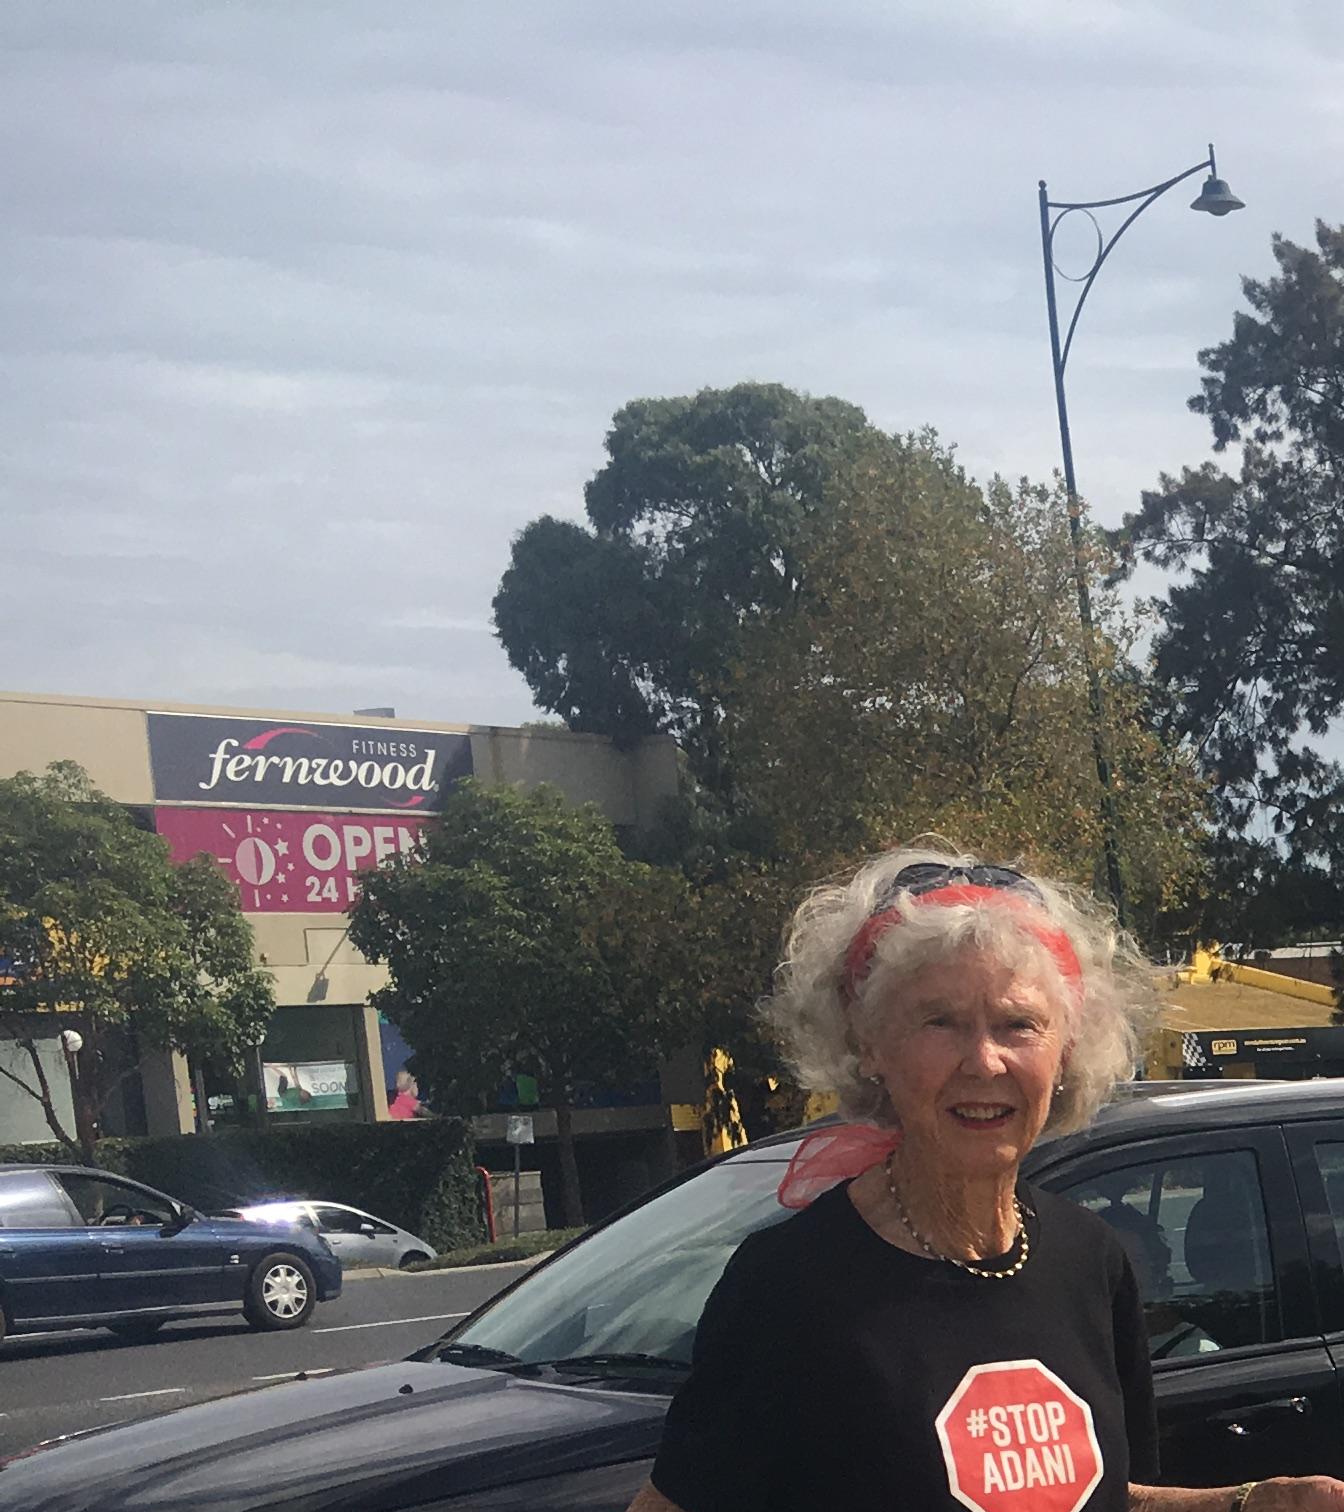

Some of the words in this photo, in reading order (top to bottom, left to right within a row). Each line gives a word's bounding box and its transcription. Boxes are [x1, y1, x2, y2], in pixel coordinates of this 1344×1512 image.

[199, 738, 437, 791] fernwood
[352, 740, 418, 758] FITNESS
[305, 875, 339, 903] 24
[966, 1400, 1067, 1448] #STOP
[983, 1443, 1077, 1494] ADANI
